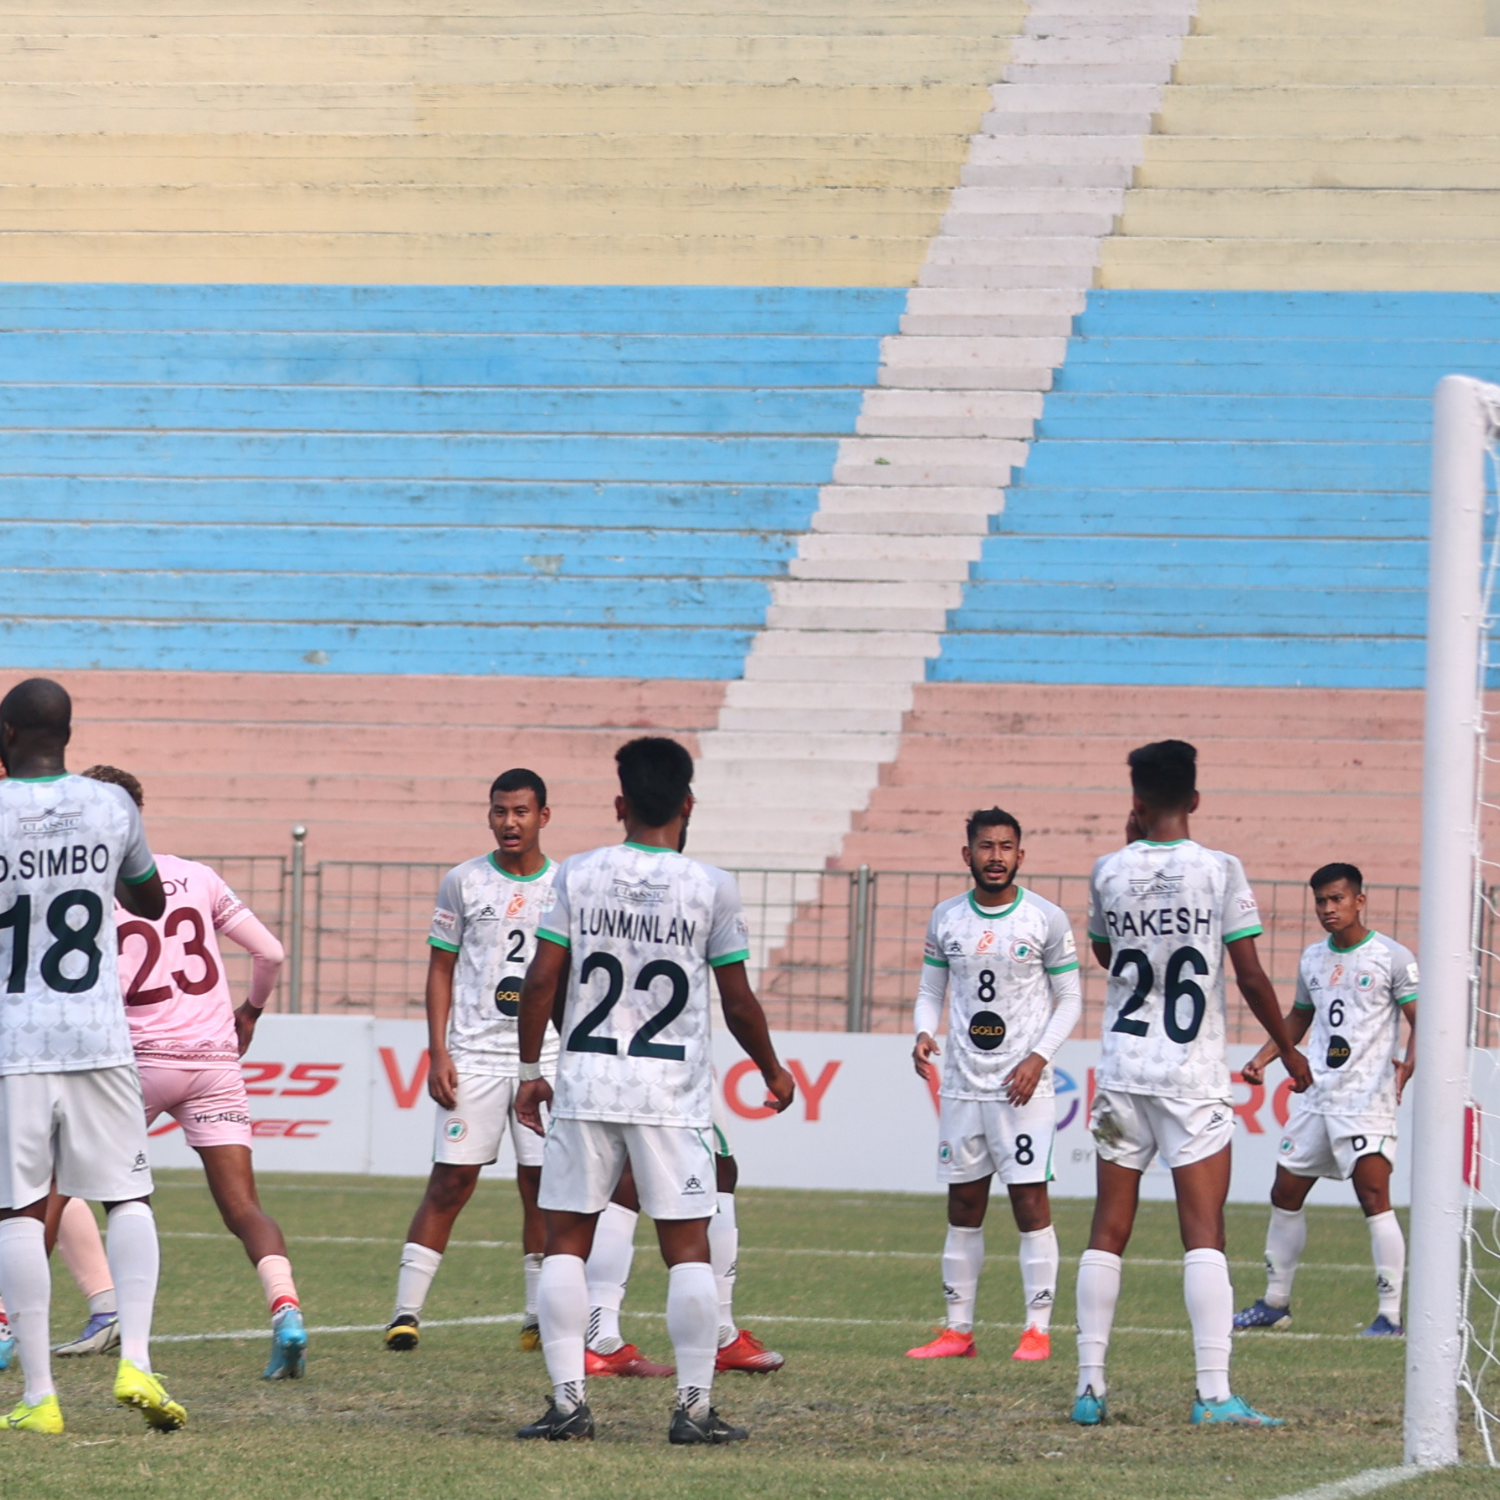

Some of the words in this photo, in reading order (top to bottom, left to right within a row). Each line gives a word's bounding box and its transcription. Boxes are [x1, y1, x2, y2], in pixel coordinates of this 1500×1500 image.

[23, 818, 79, 832] CLASSIC
[161, 877, 188, 897] OY
[580, 907, 696, 947] LUNMINLAN
[1105, 907, 1212, 937] RAKESH
[117, 907, 219, 1006] 23
[506, 929, 525, 963] 2
[978, 969, 996, 1003] 8
[1111, 945, 1209, 1044] 26
[566, 951, 689, 1061] 22
[1329, 999, 1344, 1027] 6
[241, 1062, 344, 1097] 25
[1015, 1133, 1034, 1165] 8
[1071, 1148, 1095, 1164] BY
